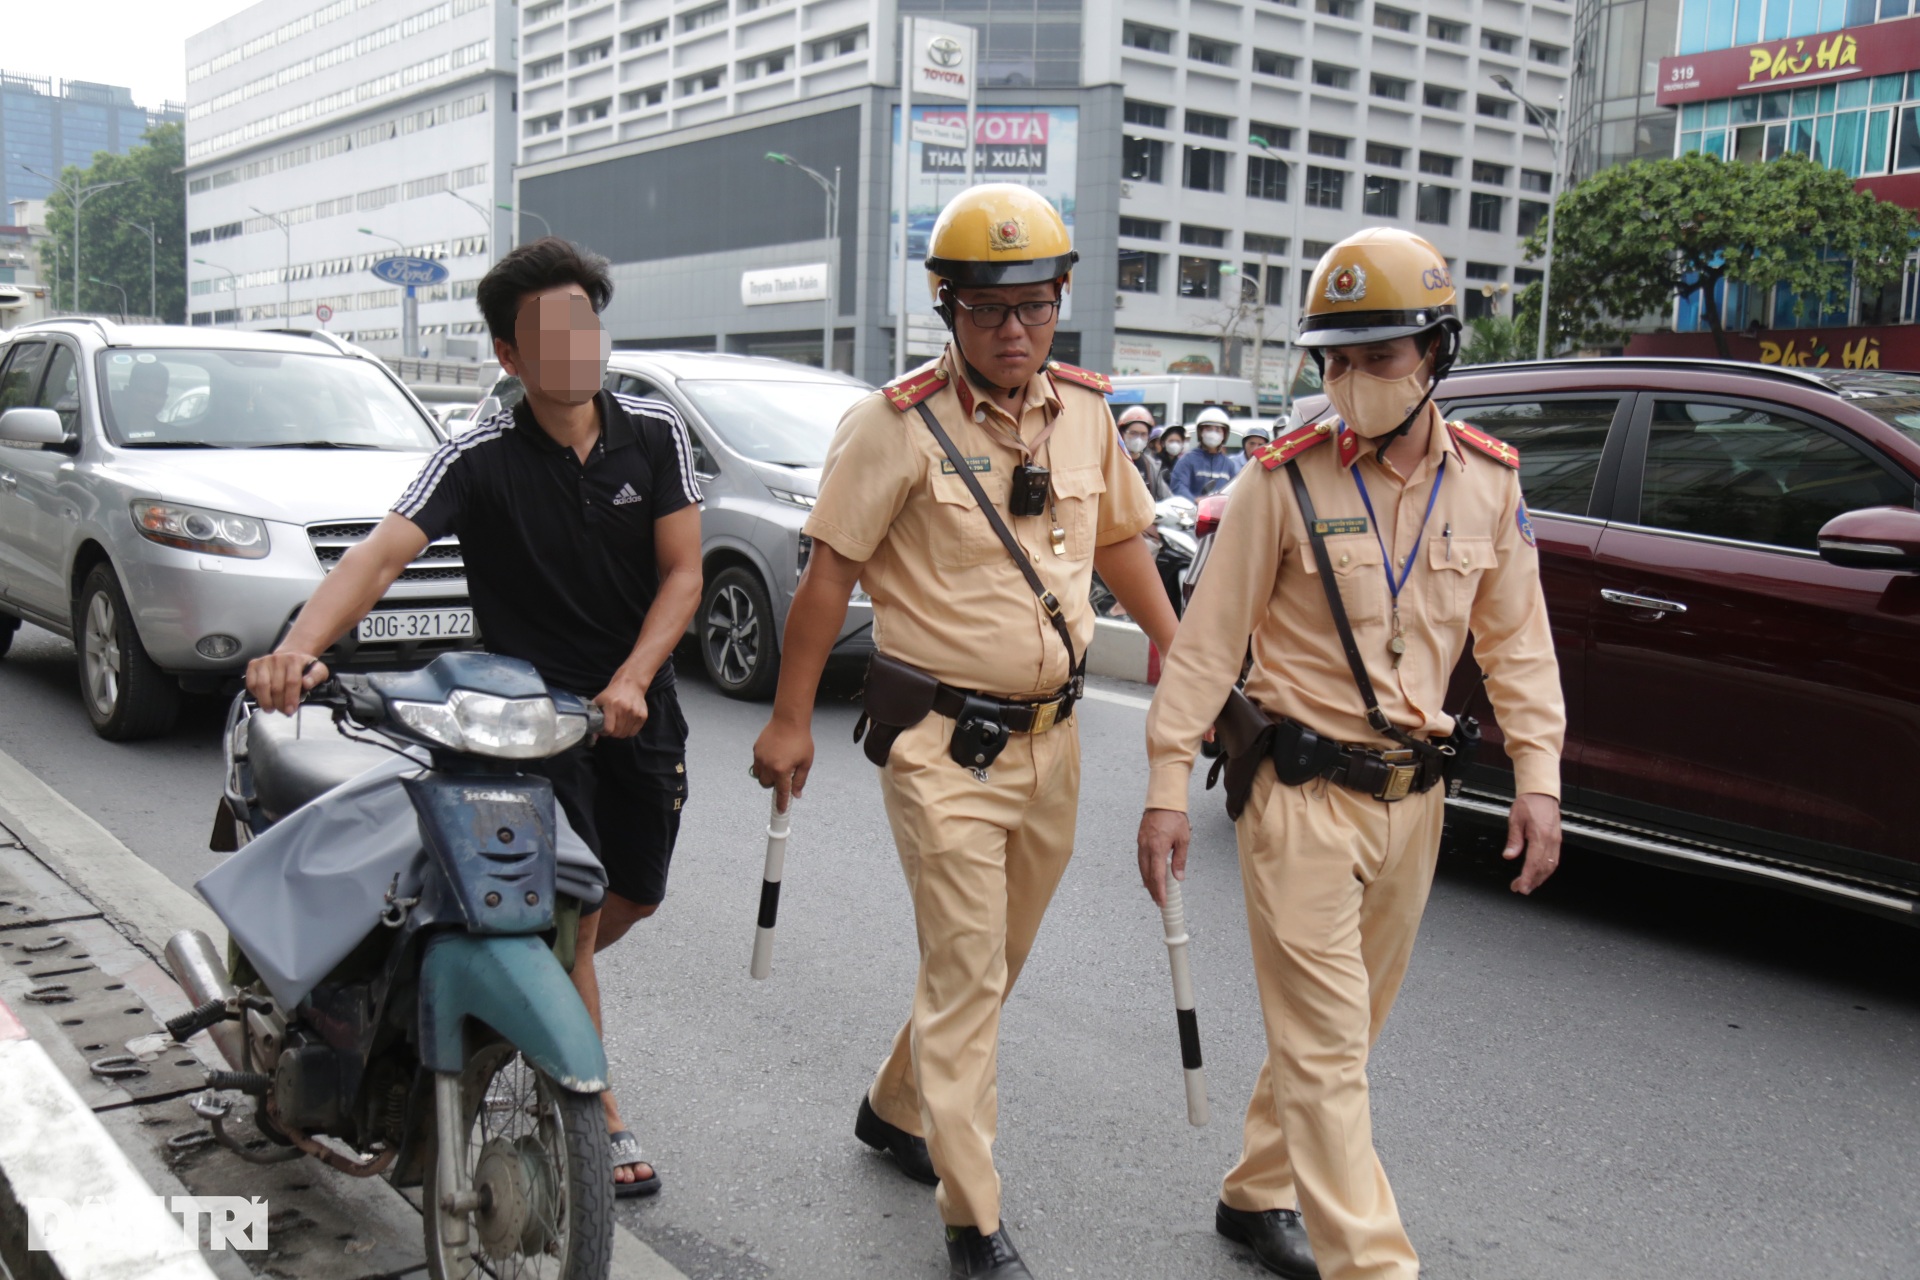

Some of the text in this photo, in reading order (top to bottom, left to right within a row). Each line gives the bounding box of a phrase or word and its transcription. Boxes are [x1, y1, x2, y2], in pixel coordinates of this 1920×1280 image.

[1816, 33, 1857, 70] Hà
[923, 67, 966, 85] TOYOTA
[1671, 66, 1694, 82] 319
[992, 148, 1042, 168] XUÂN
[387, 259, 434, 281] Ford
[1841, 336, 1880, 369] Hà
[613, 495, 642, 506] adidas
[362, 613, 471, 638] 30G-321.22
